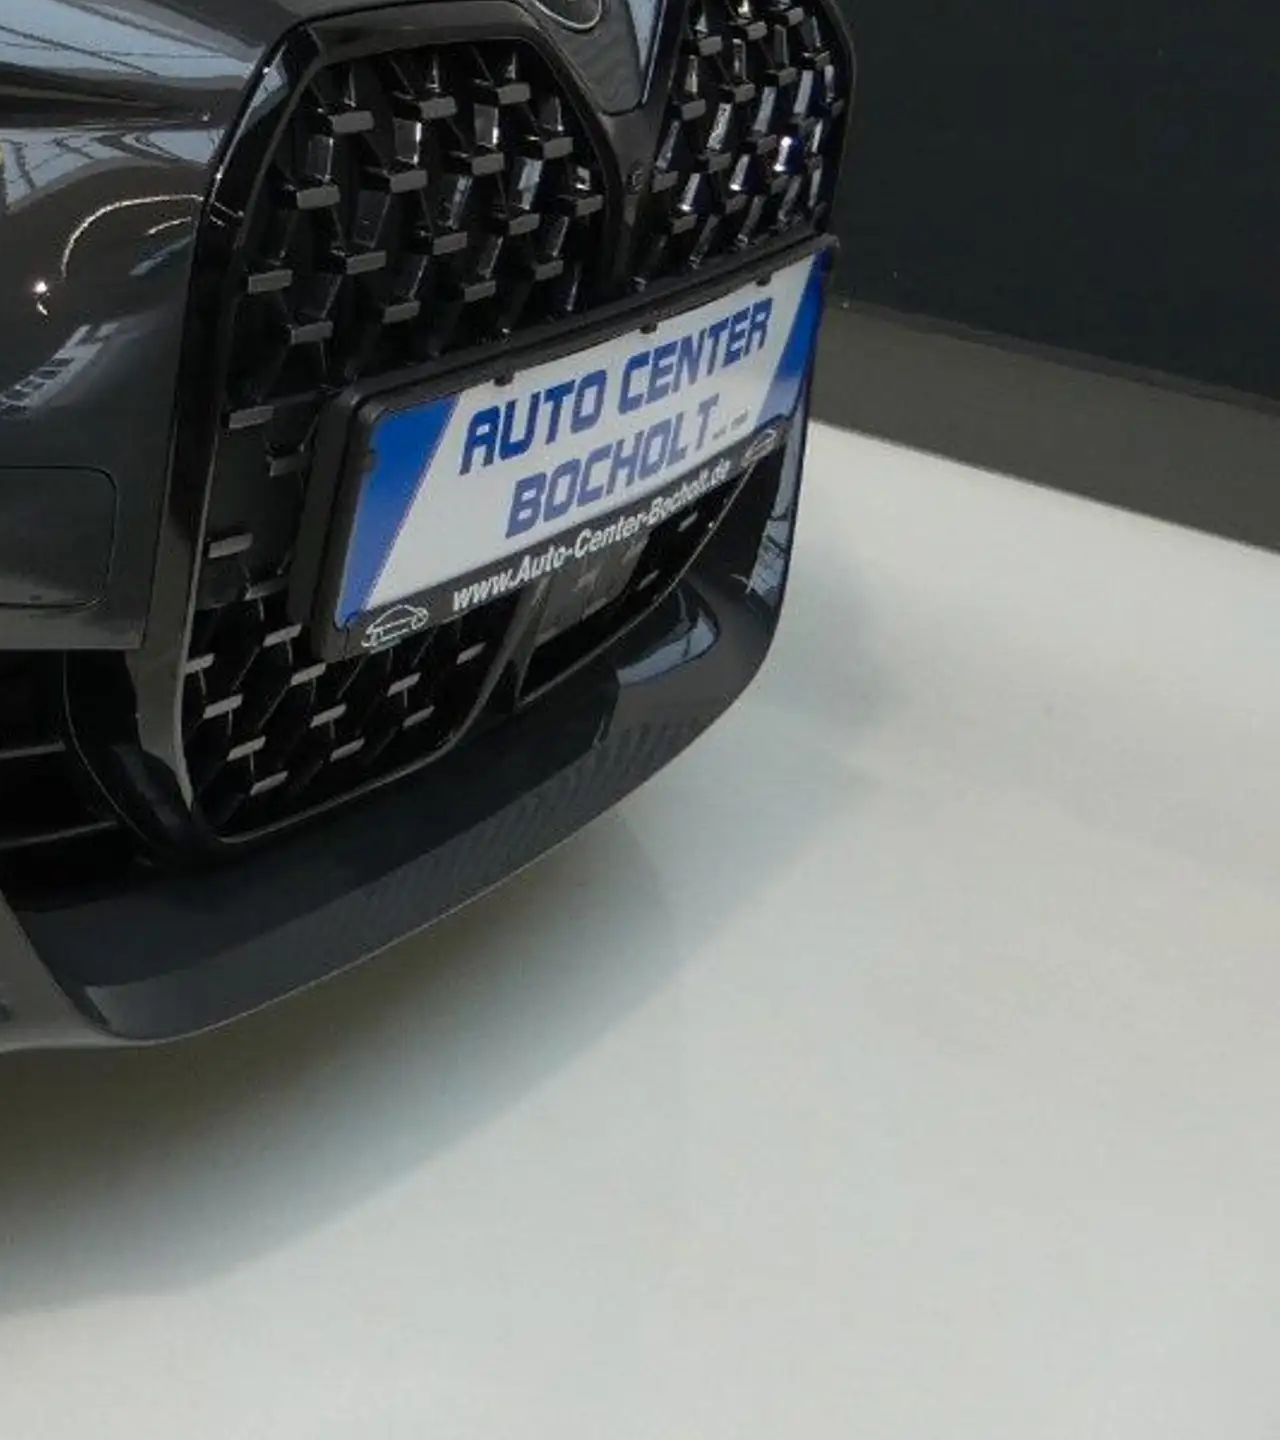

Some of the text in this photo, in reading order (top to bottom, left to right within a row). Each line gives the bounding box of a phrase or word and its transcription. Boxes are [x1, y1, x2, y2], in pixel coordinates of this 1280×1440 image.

[458, 296, 774, 476] AUTO CENTER
[503, 392, 720, 539] BOCHOLT
